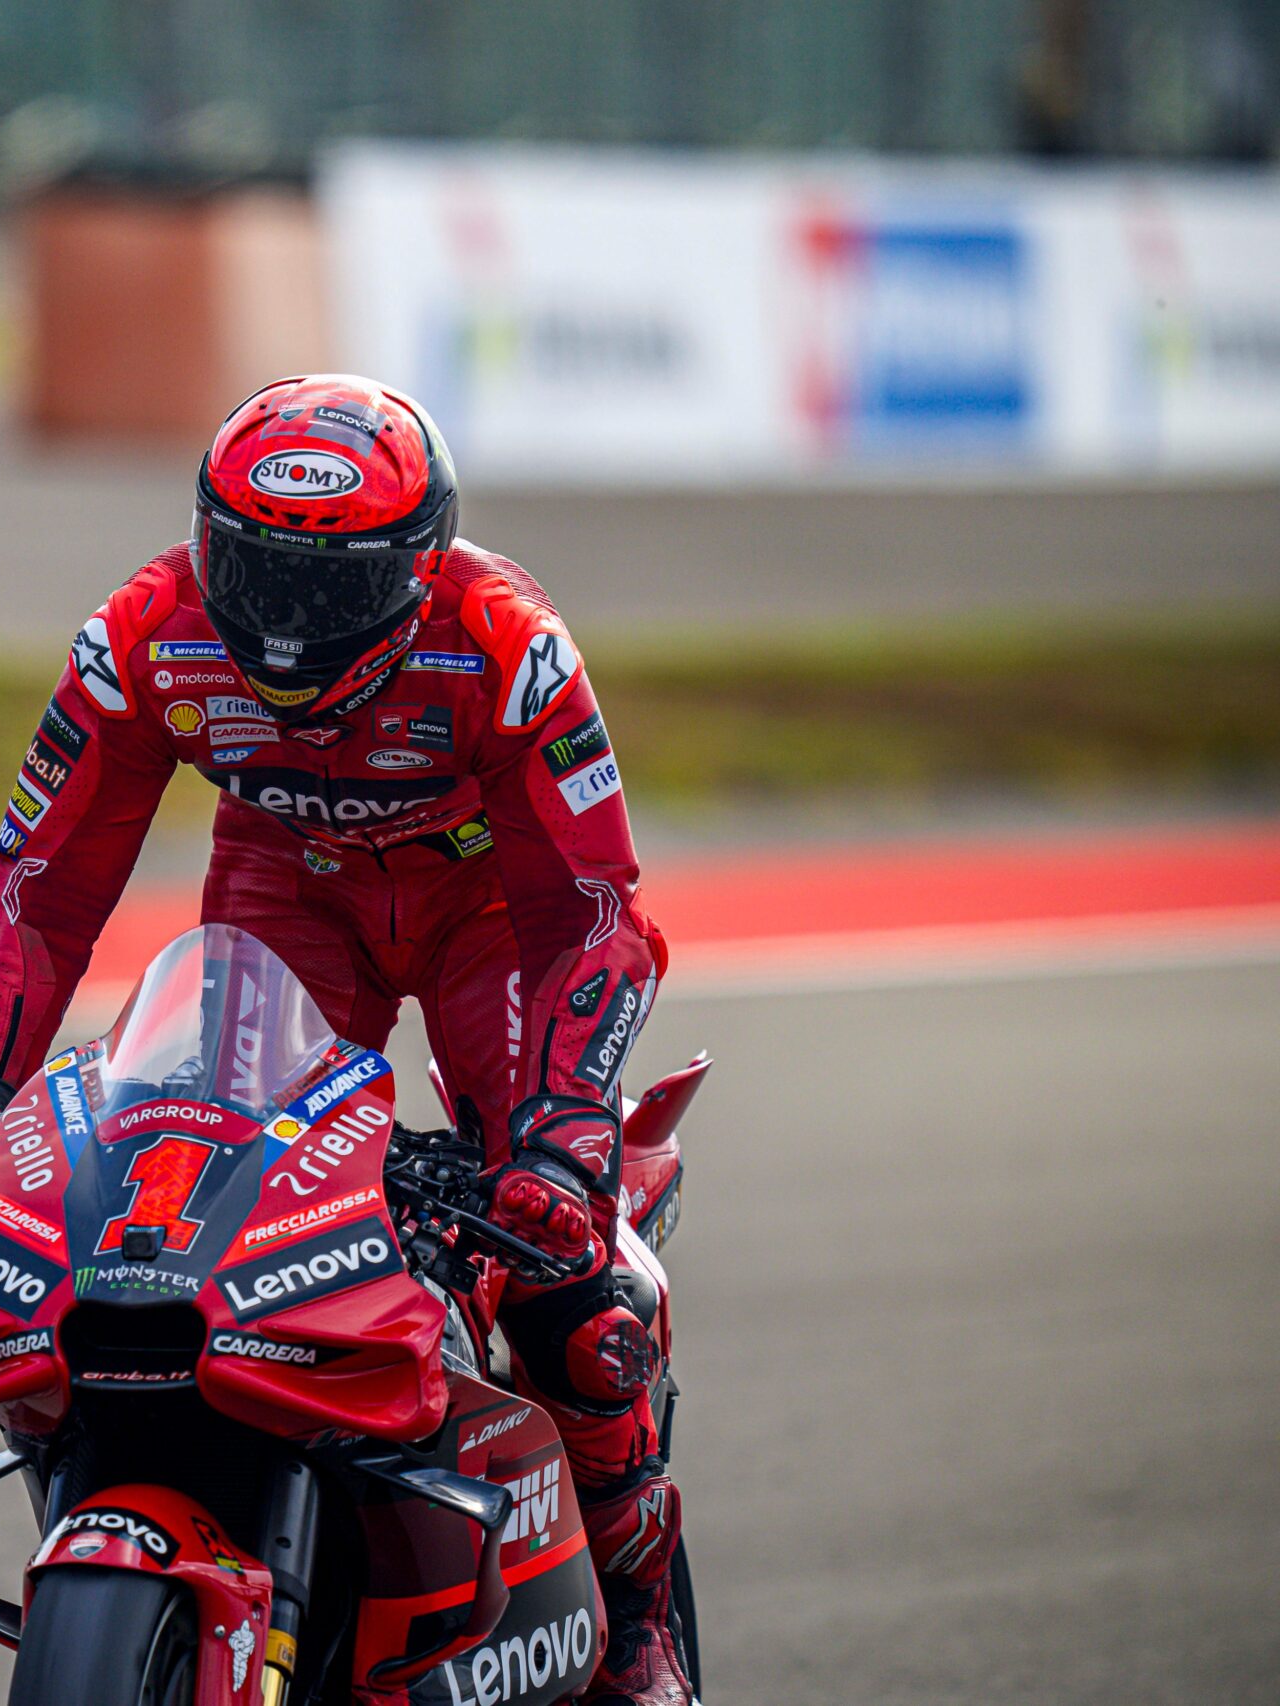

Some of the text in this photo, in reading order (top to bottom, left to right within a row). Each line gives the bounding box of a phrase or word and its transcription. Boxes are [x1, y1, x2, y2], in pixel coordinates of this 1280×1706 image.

[318, 407, 373, 432] Lenovo
[260, 460, 351, 492] SUOMY
[211, 510, 243, 530] CARRERA
[270, 531, 315, 545] MONSTER
[347, 540, 391, 549] CARRERA
[174, 647, 226, 655] MICHELIN
[267, 640, 300, 651] FASSI
[423, 656, 477, 668] MICHELIN
[175, 672, 235, 684] motorola
[335, 668, 390, 715] Lenovo
[212, 728, 277, 738] CARRERA
[410, 721, 449, 735] Lenovo
[26, 740, 67, 790] ba.it
[212, 750, 249, 763] SAP
[374, 753, 426, 766] SUOMY
[586, 992, 637, 1082] Lenovo
[304, 1057, 381, 1118] ADVANCE
[55, 1076, 88, 1135] ADVANCE
[119, 1105, 223, 1130] VARGROUP
[4, 1106, 54, 1192] riello
[298, 1104, 389, 1181] riello
[93, 1134, 218, 1255] 1
[244, 1188, 380, 1245] FRECCIAROSSA
[97, 1264, 200, 1292] MONSTER
[224, 1237, 389, 1311] Lenovo
[110, 1282, 182, 1296] ENERGY
[213, 1335, 317, 1364] CARRERA
[82, 1370, 192, 1381] aruba.it
[476, 1406, 532, 1446] DAIKO
[443, 1607, 592, 1706] Lenovo
